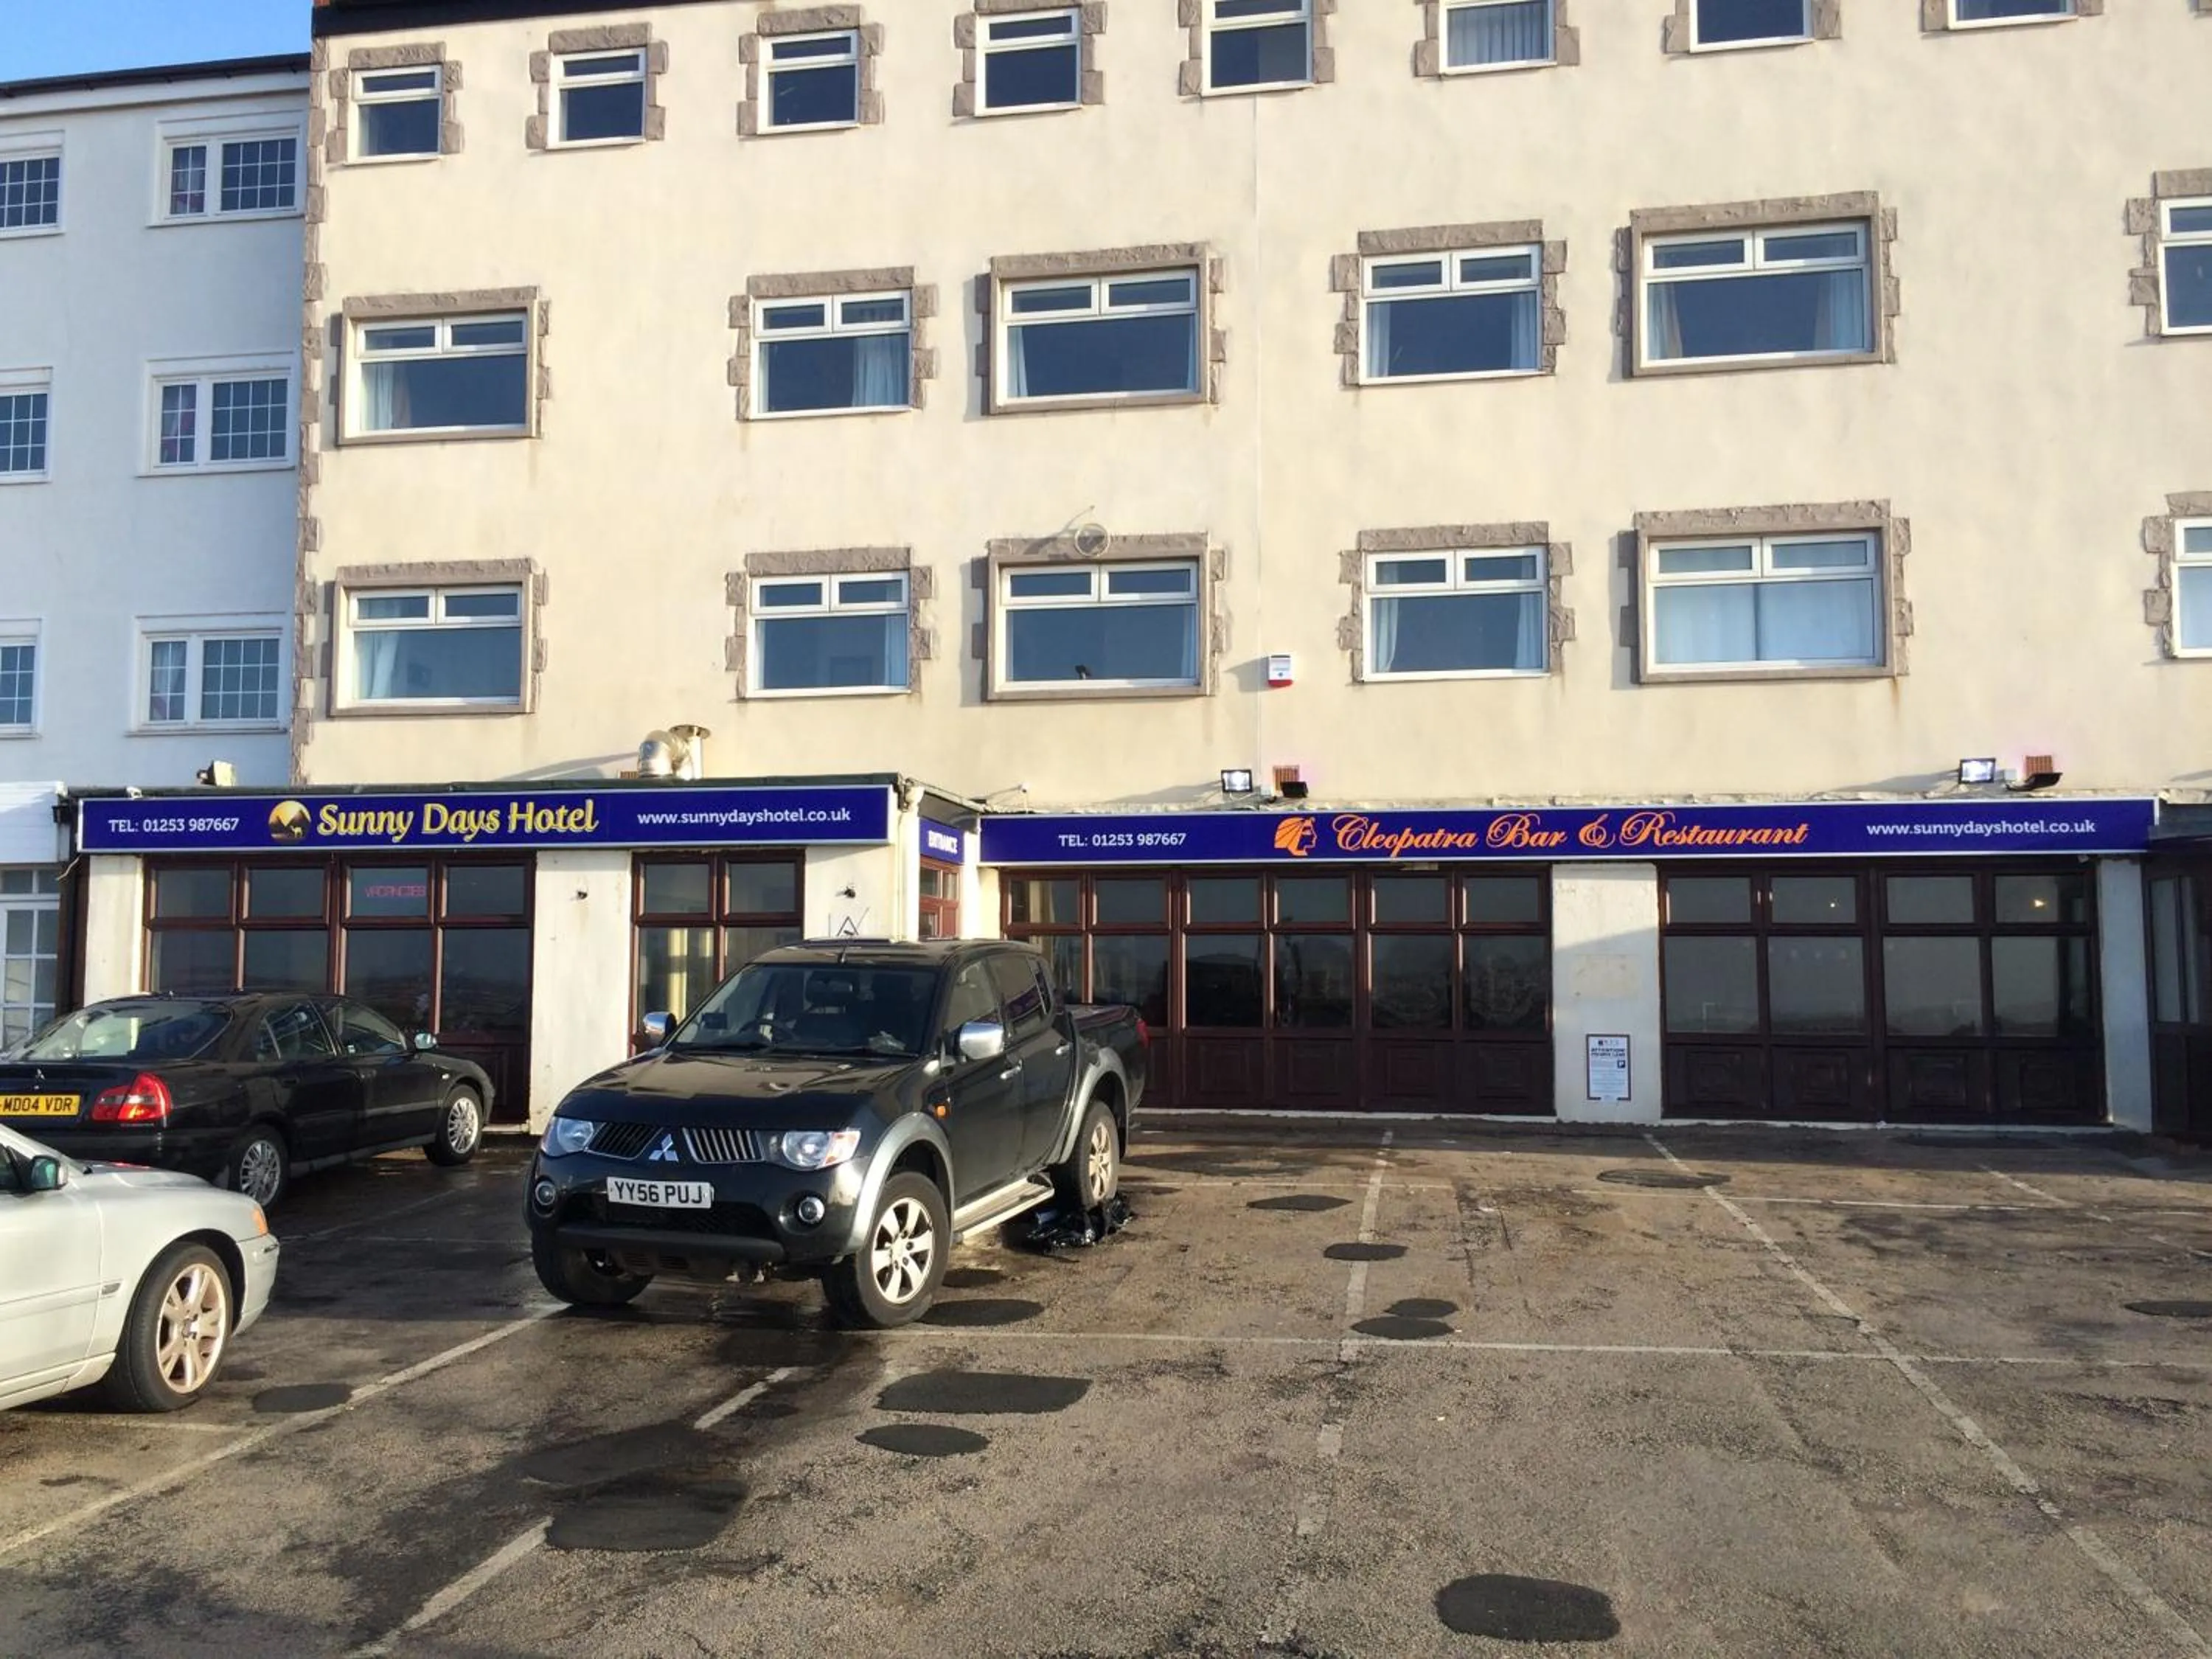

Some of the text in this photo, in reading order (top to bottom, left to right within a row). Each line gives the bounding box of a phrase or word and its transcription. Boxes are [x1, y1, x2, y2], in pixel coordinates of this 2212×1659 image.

[108, 817, 240, 832] TEL: 01253 987667
[316, 799, 599, 844] Sunny Days Hotel
[637, 807, 852, 827] www.sunnydayshotel.co.uk
[1332, 810, 1812, 858] Cleopatra Bar & Restaurant
[1866, 818, 2096, 838] www.sunnydayshotel.co.uk
[1058, 832, 1187, 846] TEL: 01253 987667
[45, 1096, 74, 1112] VDR
[614, 1180, 703, 1204] YY56 PUJ
